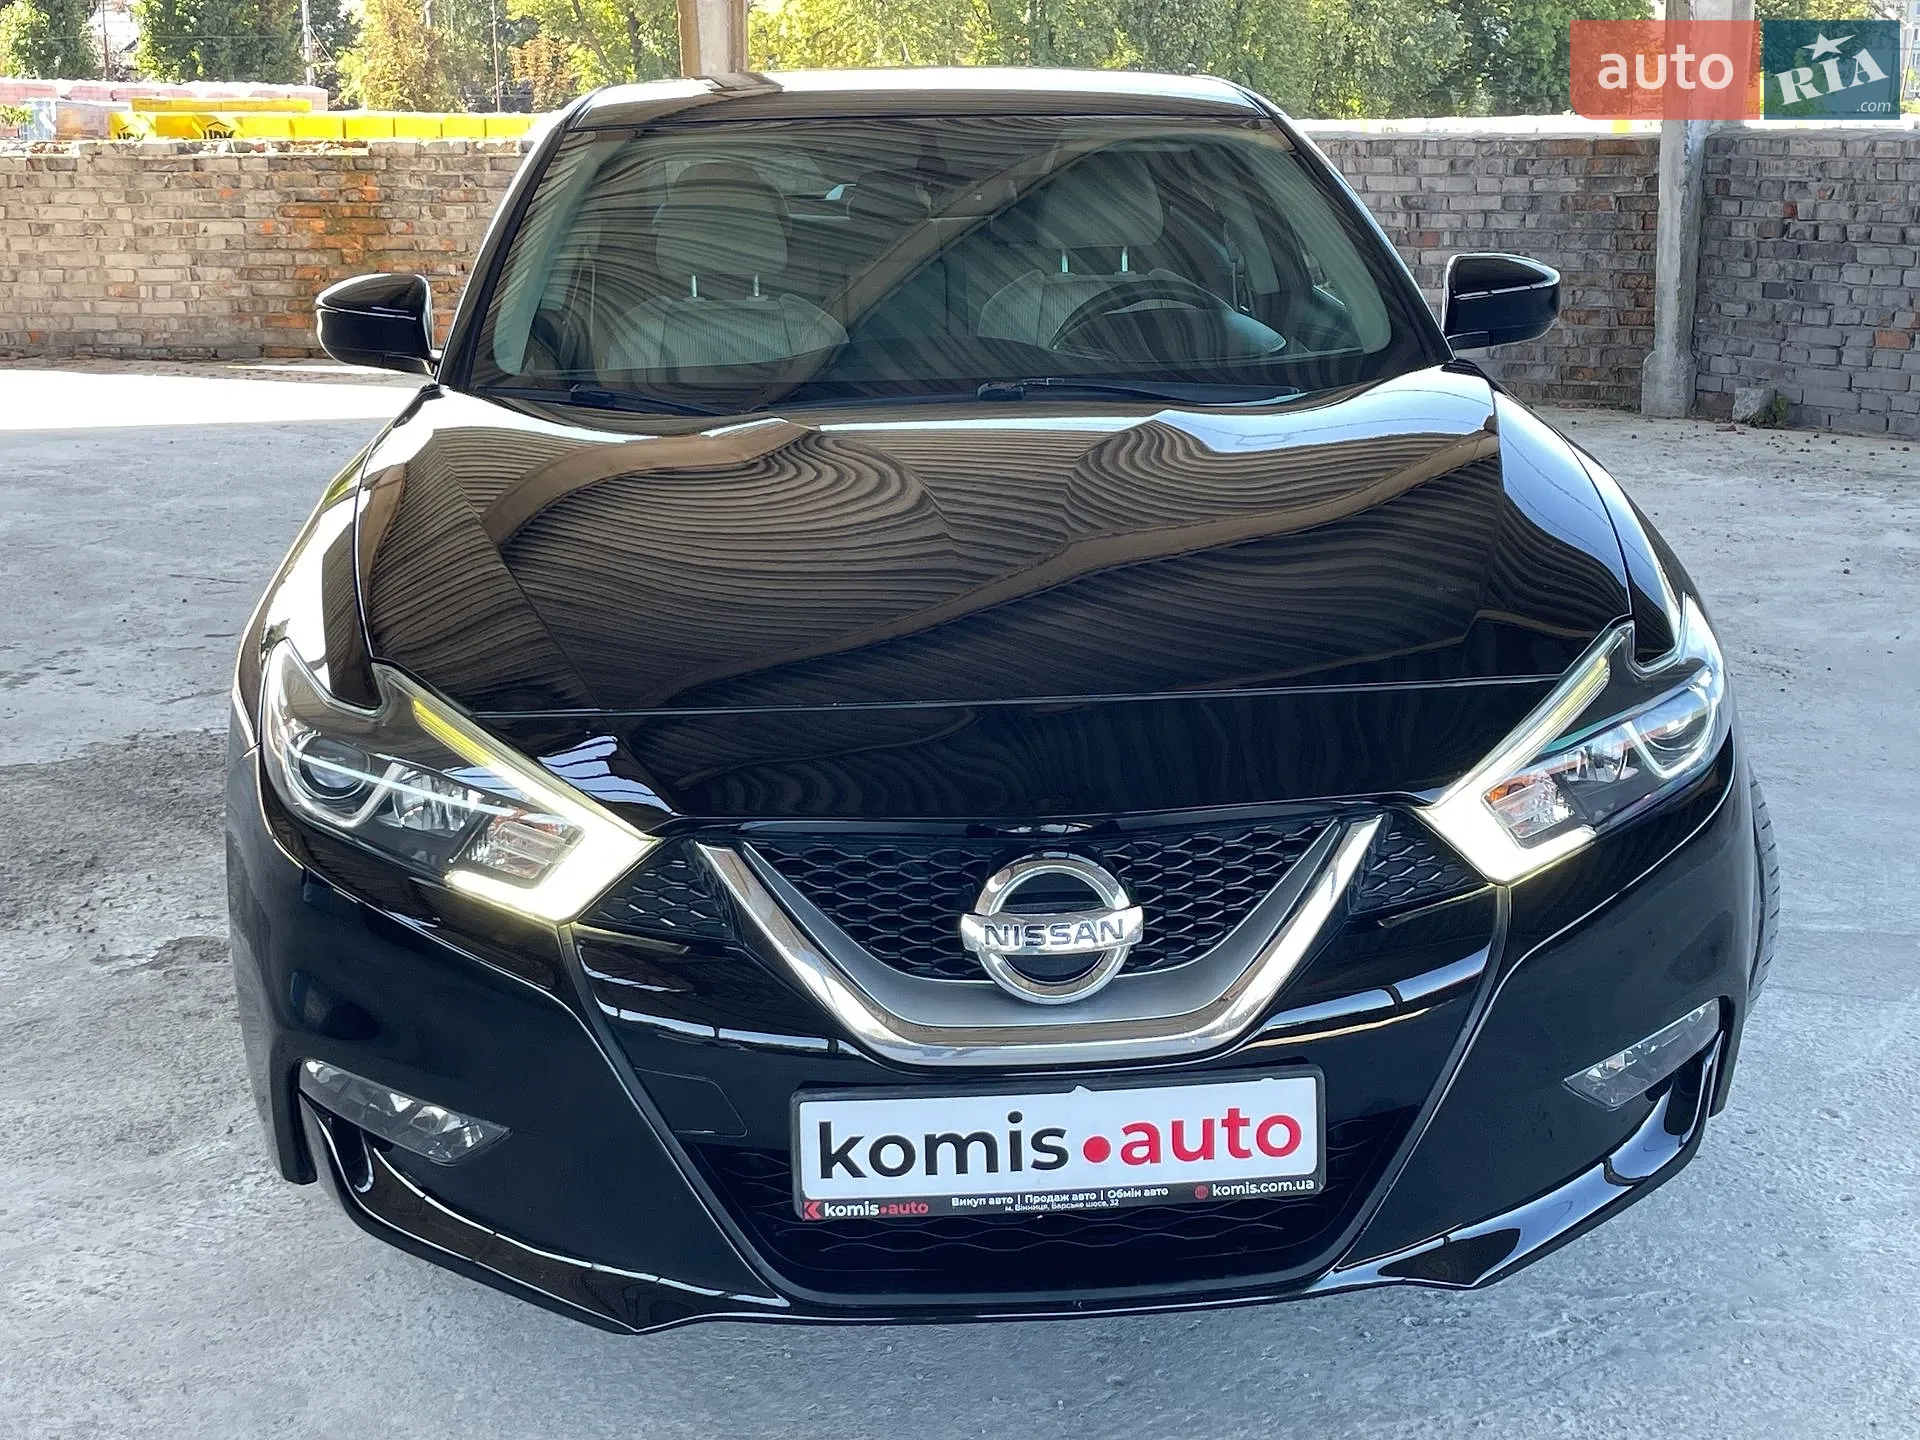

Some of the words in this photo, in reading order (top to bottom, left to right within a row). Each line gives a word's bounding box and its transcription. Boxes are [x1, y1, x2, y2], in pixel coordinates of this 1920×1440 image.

[984, 918, 1123, 947] NISSAN
[951, 1196, 986, 1208] Викуп
[988, 1195, 1014, 1206] авто
[1024, 1193, 1069, 1205] Продаж
[1071, 1191, 1097, 1201] авто
[1107, 1187, 1141, 1199] Обмін
[1143, 1186, 1169, 1197] авто
[1212, 1180, 1315, 1197] komis.com.ua
